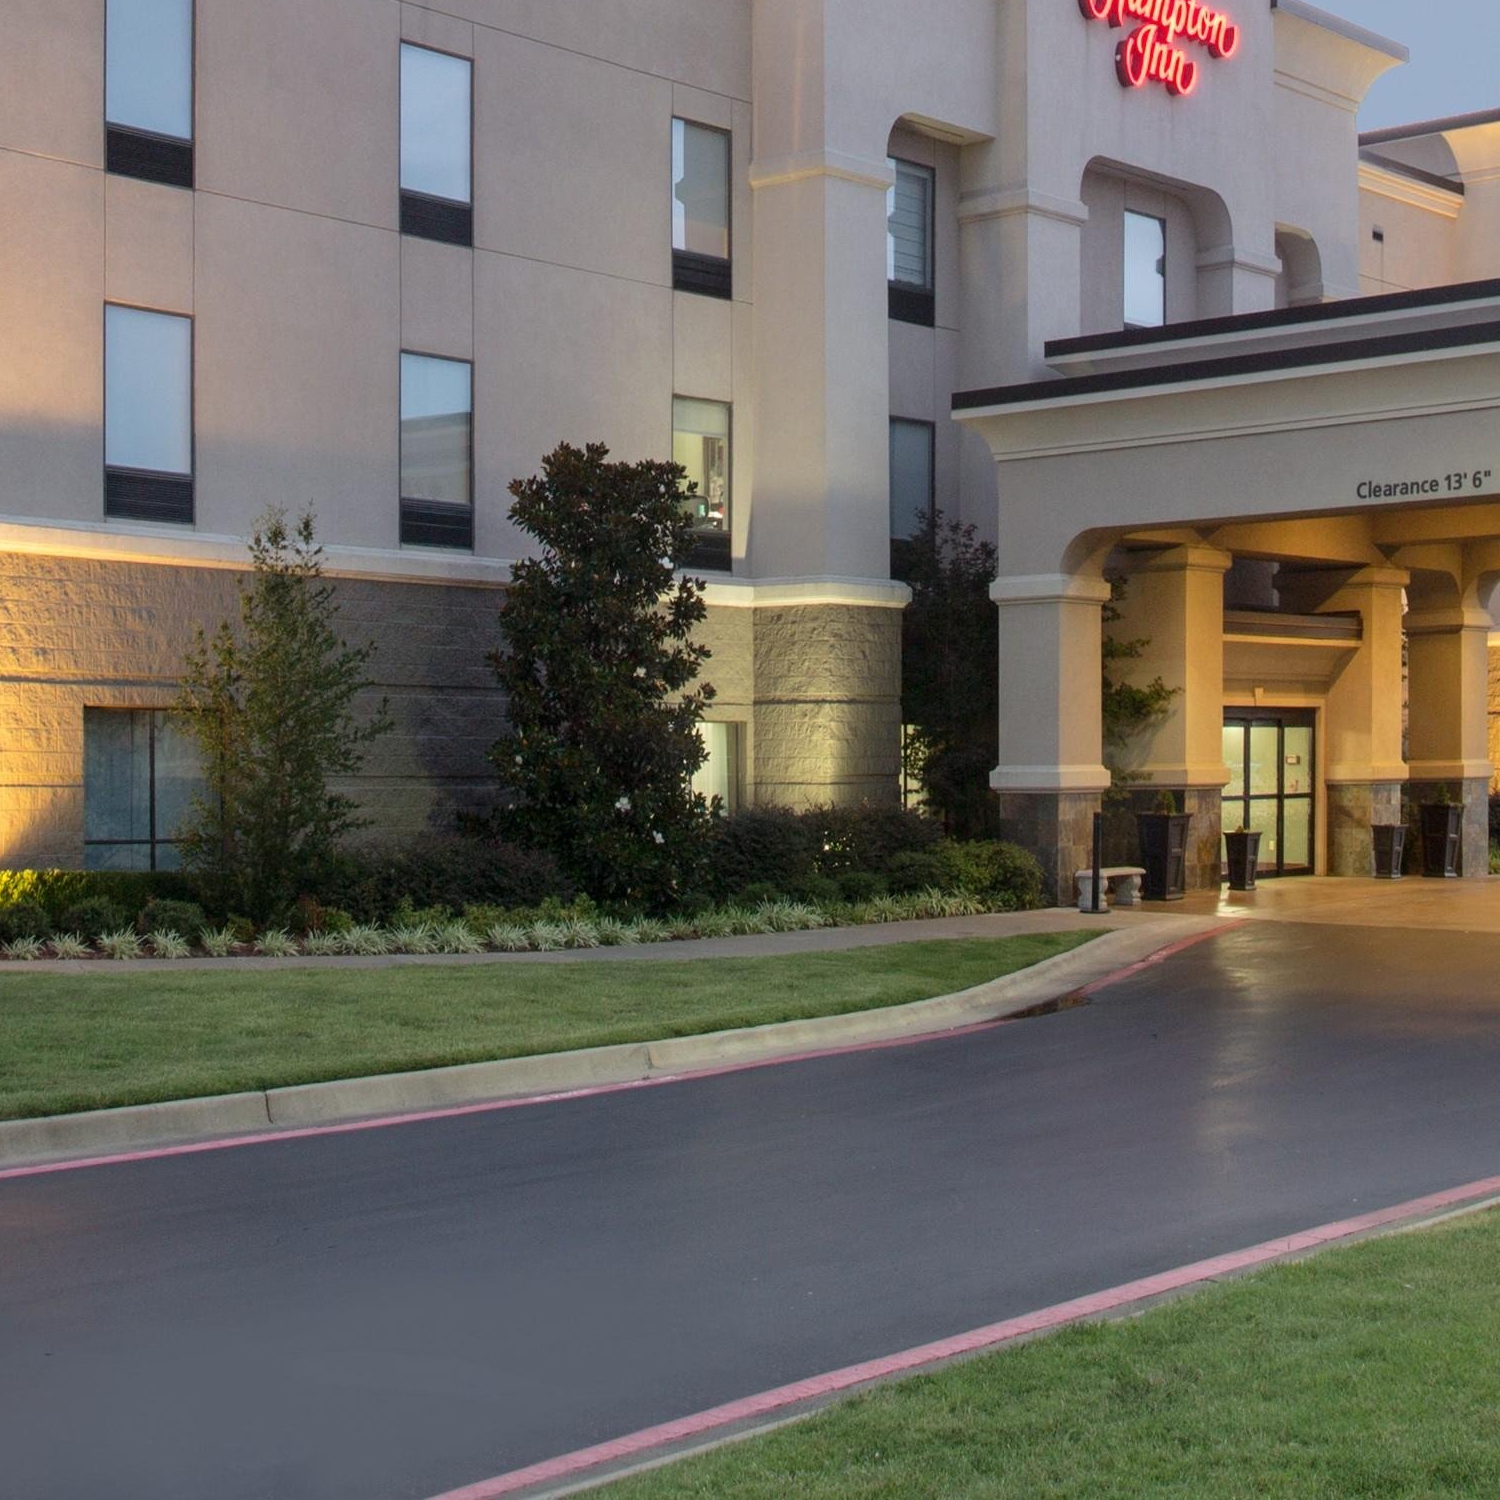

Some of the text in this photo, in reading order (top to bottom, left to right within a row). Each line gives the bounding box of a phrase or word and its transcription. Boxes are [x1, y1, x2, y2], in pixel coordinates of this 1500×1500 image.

[1124, 22, 1198, 97] Inn
[1356, 470, 1492, 499] Clearance 13' 6"
